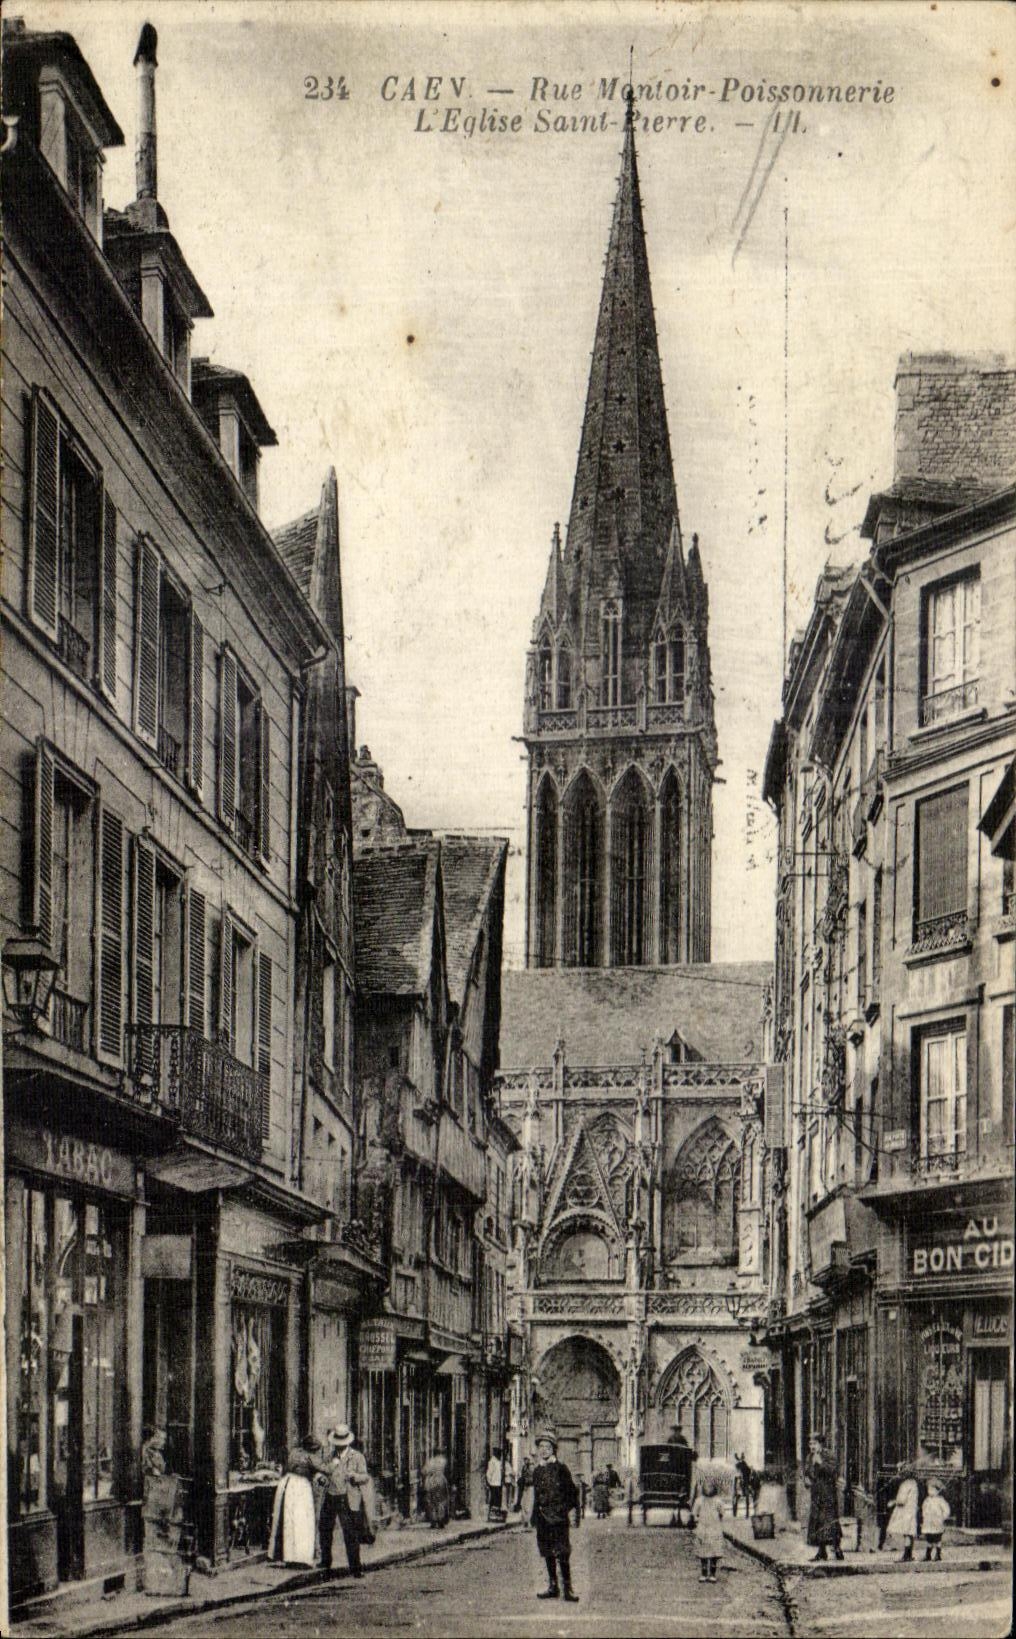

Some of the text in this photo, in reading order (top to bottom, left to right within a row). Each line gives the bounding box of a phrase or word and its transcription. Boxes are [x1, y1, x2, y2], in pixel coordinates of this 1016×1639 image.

[43, 1131, 112, 1190] TABAC
[963, 1216, 998, 1239] AU
[913, 1246, 963, 1274] BON
